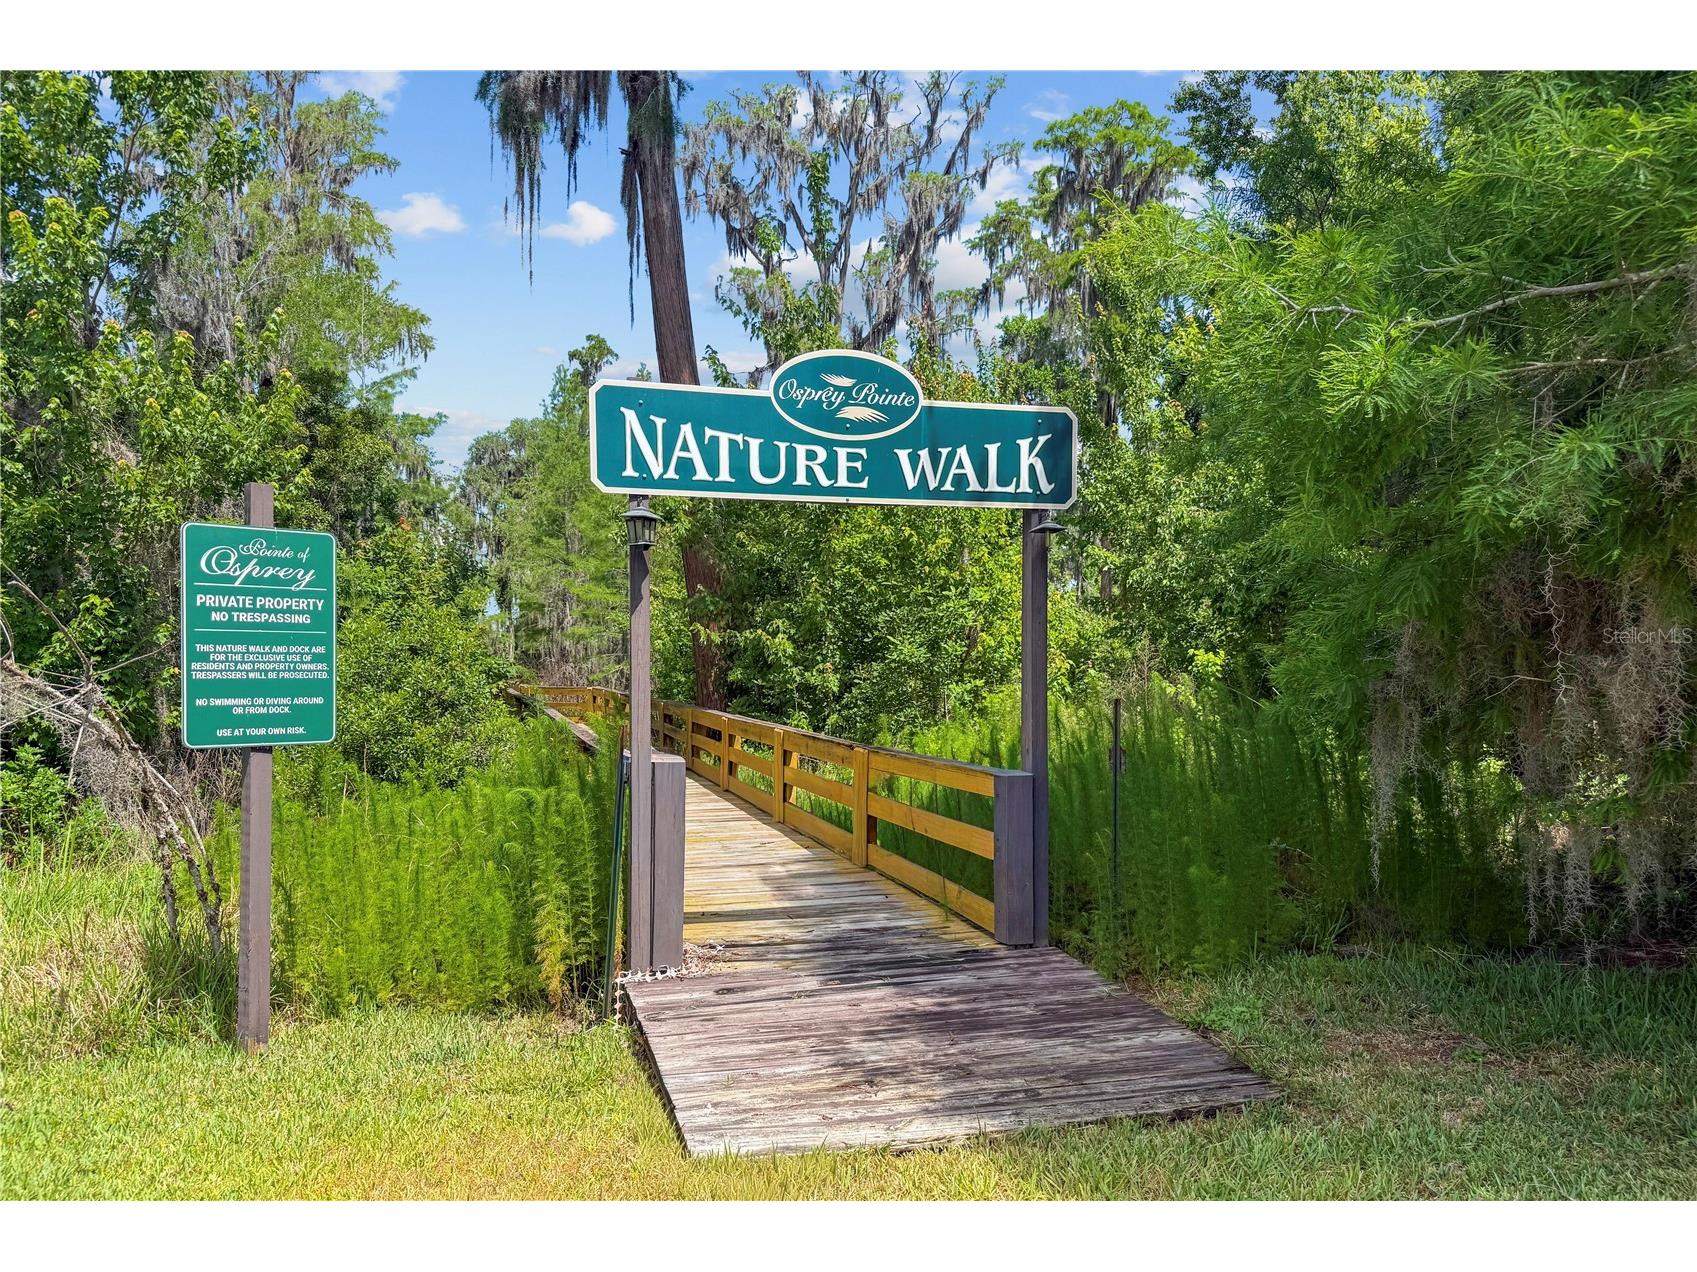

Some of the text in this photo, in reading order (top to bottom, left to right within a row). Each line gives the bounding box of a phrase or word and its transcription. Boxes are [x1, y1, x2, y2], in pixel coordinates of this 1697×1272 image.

[778, 378, 915, 408] Osprey Pointe
[620, 406, 1055, 495] NATURE WALK
[239, 538, 310, 563] Pointe of
[200, 546, 315, 591] Osprey
[196, 594, 324, 610] PRIVATE PROPERTY
[211, 611, 310, 623] NO TRESPASSING
[195, 644, 214, 652] THIS
[216, 644, 247, 652] NATURE
[196, 698, 207, 706] NO
